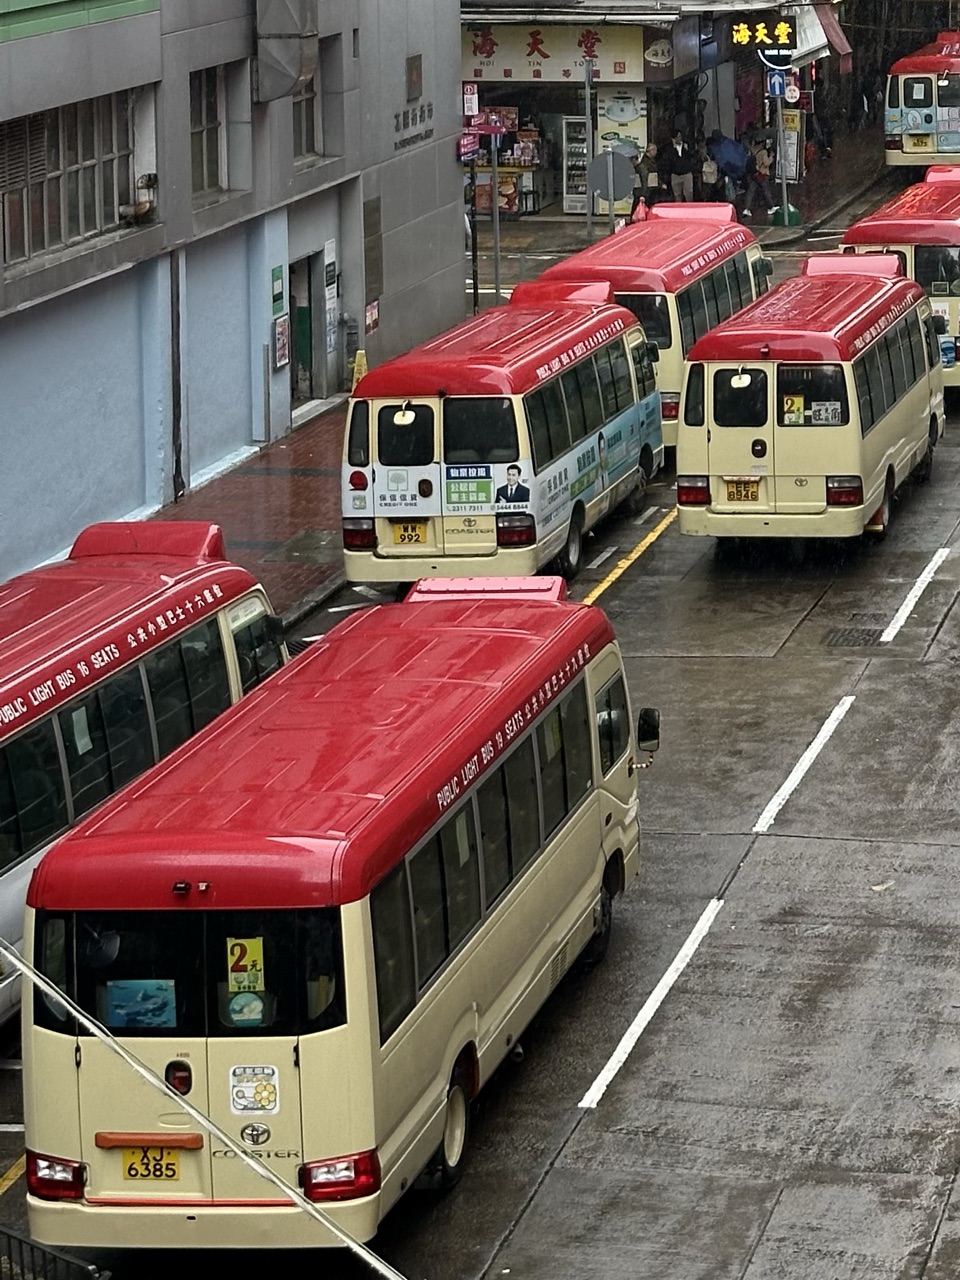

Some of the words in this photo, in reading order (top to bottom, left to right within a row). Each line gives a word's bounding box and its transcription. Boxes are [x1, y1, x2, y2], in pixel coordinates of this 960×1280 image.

[472, 27, 602, 59] 海天堂
[732, 21, 792, 45] 海天堂
[786, 398, 795, 413] 2
[399, 533, 421, 543] 992
[28, 680, 57, 706] LIGHT
[55, 669, 76, 691] BUS
[77, 661, 90, 677] 16
[90, 644, 120, 669] SEATS
[436, 776, 460, 811] PUBLIC
[460, 755, 480, 786] LIGHT
[481, 740, 494, 765] BUS
[505, 711, 524, 739] SEATS
[141, 1147, 164, 1162] XJ
[127, 1162, 177, 1179] 6385
